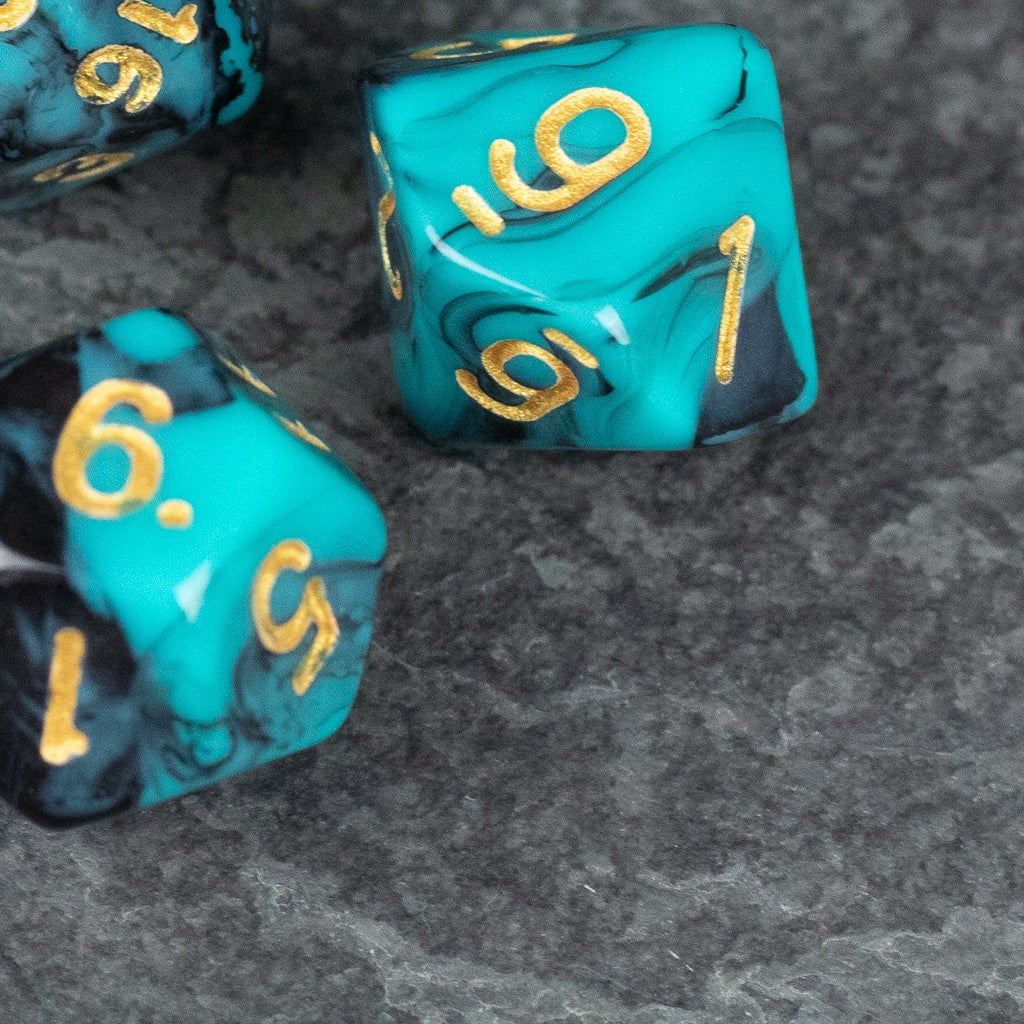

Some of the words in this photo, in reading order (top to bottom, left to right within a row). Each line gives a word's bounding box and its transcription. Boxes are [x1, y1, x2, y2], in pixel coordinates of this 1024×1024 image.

[714, 215, 755, 385] 1
[252, 538, 339, 695] 5
[39, 627, 88, 765] 1
